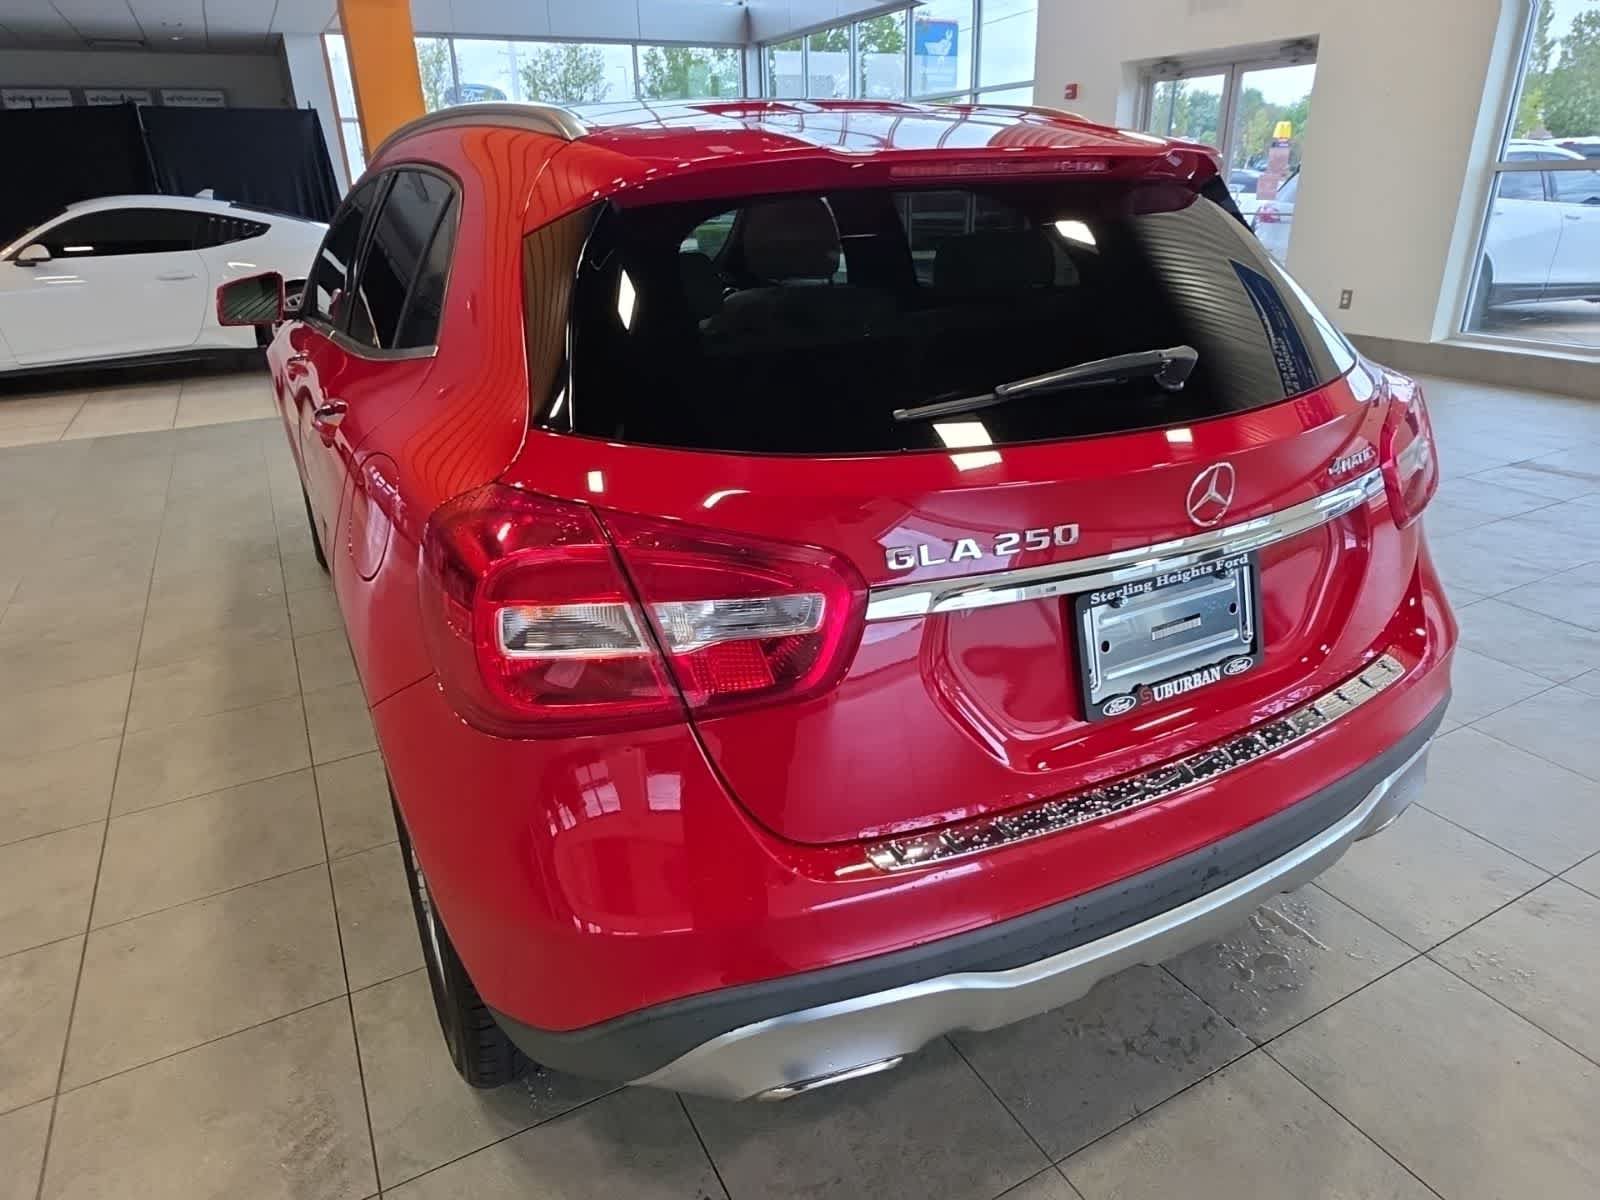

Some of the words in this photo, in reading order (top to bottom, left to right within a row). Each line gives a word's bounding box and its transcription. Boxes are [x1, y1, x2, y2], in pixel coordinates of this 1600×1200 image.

[886, 538, 982, 570] GLA
[994, 523, 1079, 555] 250
[1090, 580, 1153, 605] Sterling
[1156, 565, 1213, 587] Heights
[1215, 553, 1249, 571] Ford
[1227, 658, 1250, 673] Ford
[1140, 666, 1220, 705] SUBURBAN
[1107, 697, 1132, 715] Ford
